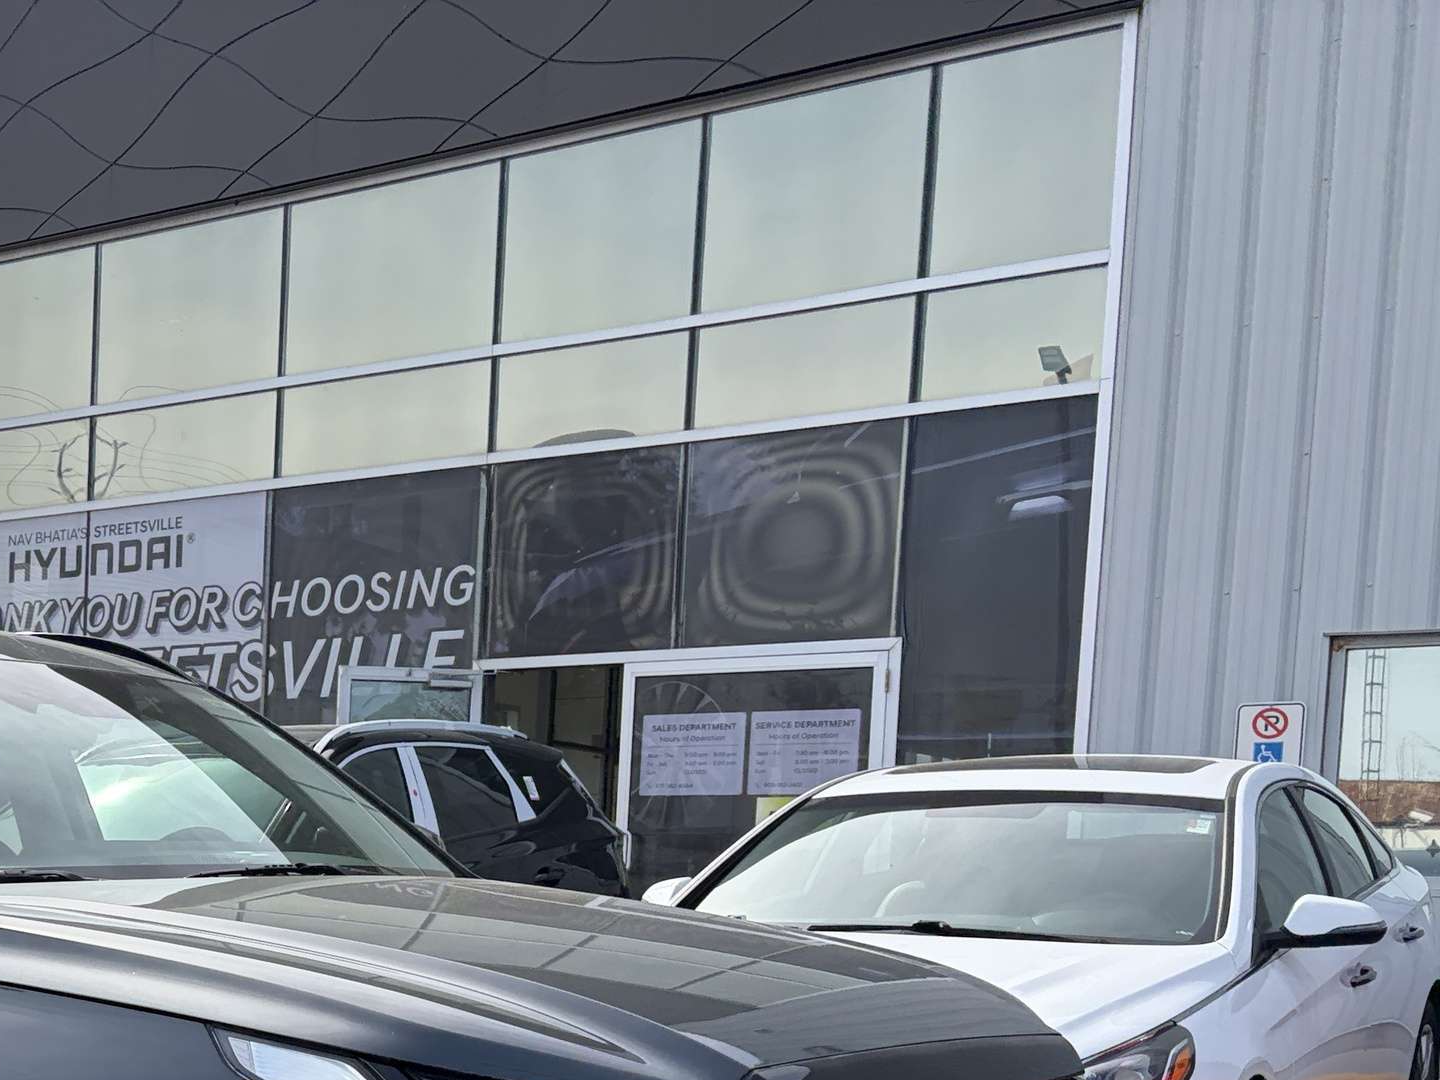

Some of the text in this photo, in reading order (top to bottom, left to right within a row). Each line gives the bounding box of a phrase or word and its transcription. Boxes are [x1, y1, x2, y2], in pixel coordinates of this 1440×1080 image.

[8, 516, 183, 547] NAV BHATIA'S STREETSVILLE
[60, 592, 144, 637] YOU
[145, 585, 230, 632] FOR
[232, 564, 476, 627] CHOOSING
[652, 722, 737, 733] SALES DEPARTMENT
[755, 719, 856, 730] SERVICE DEPARTMENT
